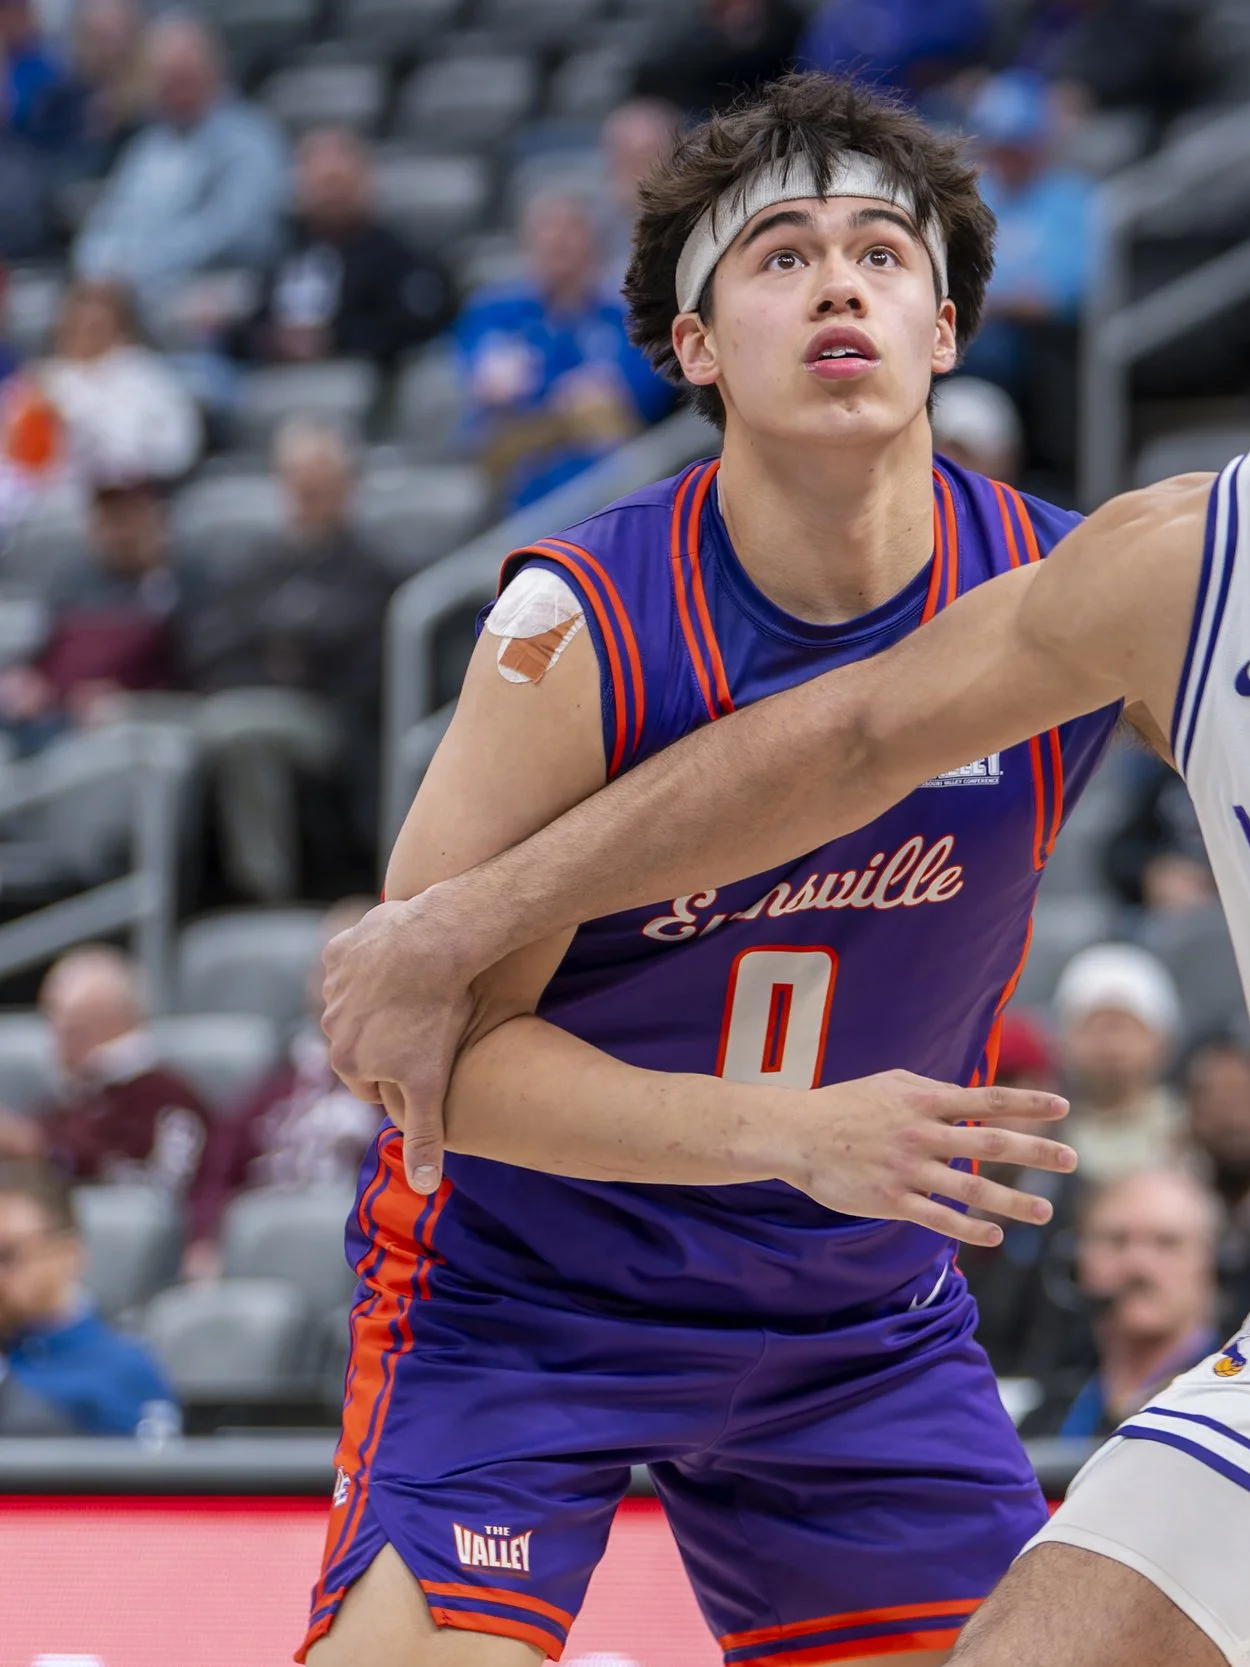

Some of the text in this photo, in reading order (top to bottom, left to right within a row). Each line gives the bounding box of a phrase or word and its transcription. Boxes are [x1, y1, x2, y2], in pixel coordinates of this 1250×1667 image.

[642, 834, 964, 941] Ensville
[714, 945, 839, 1091] 0
[453, 1523, 533, 1572] VALLEY
[484, 1525, 511, 1537] THE
